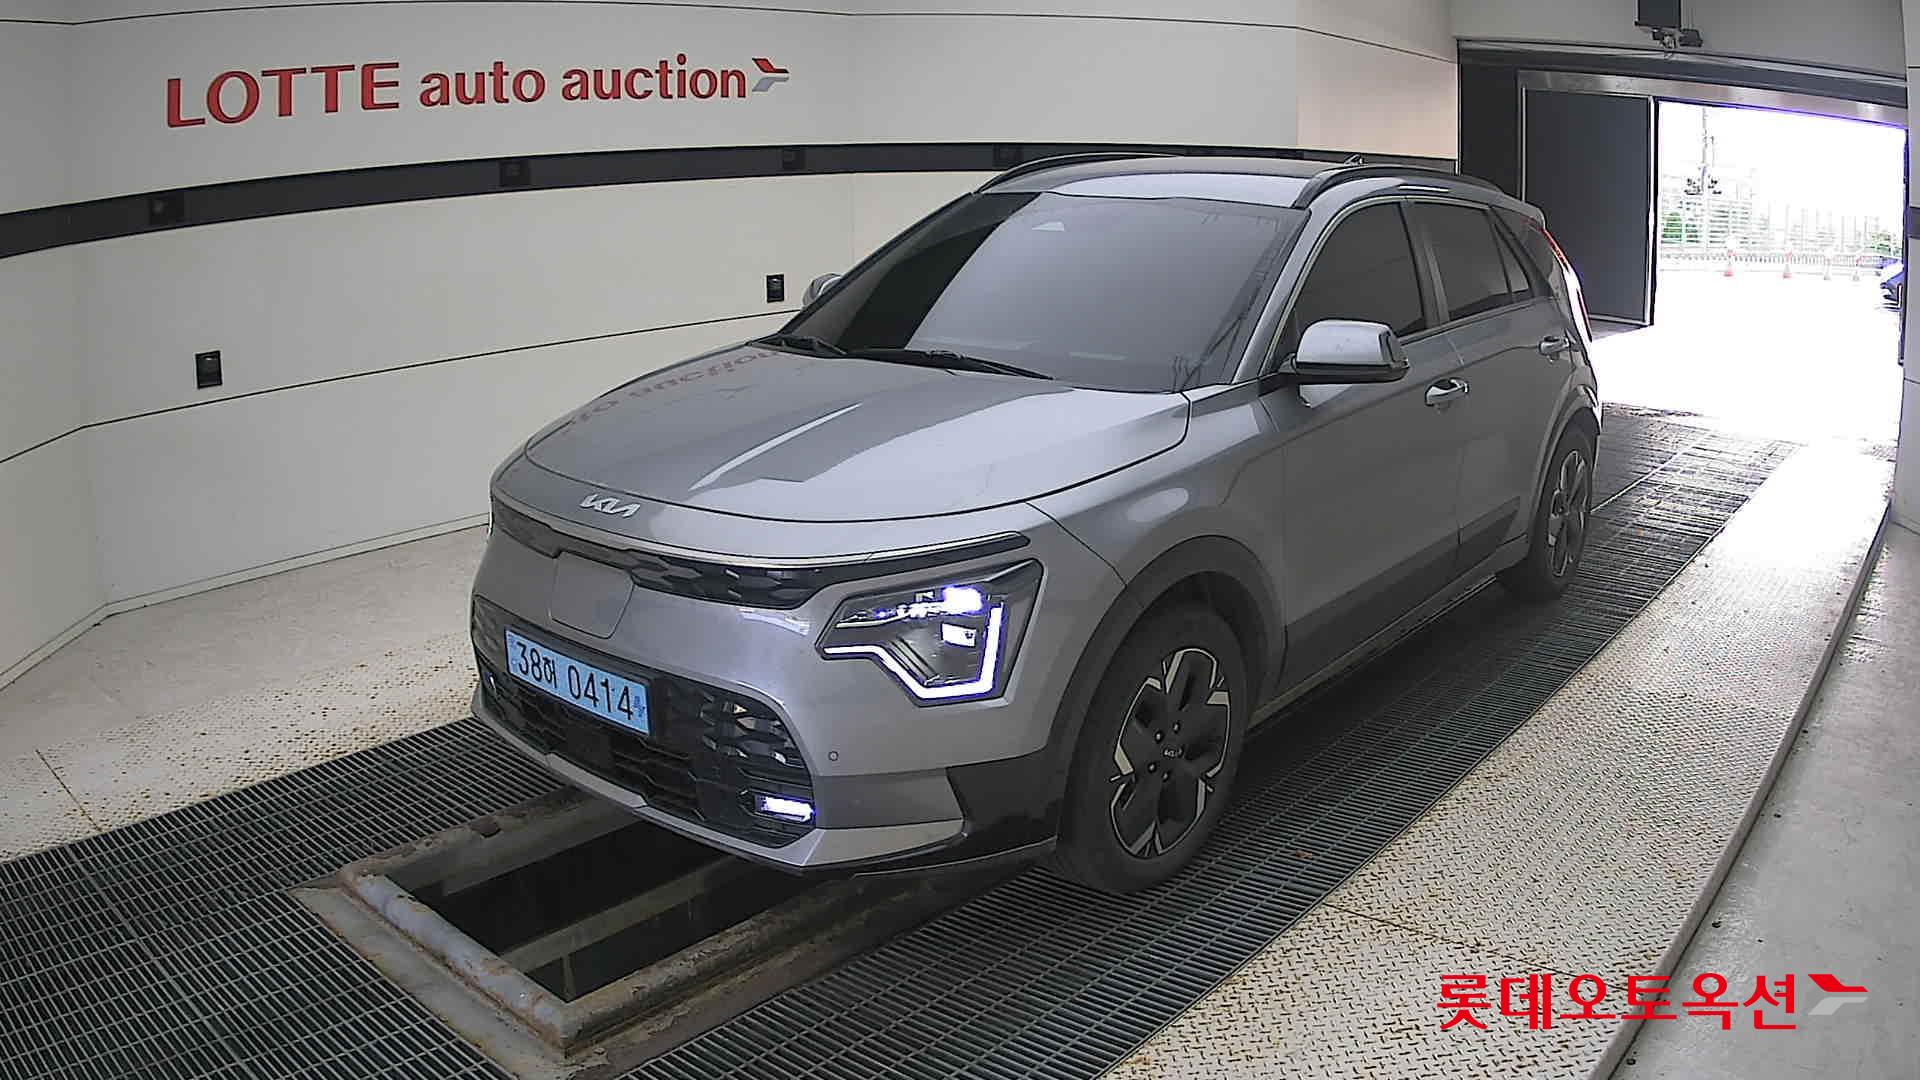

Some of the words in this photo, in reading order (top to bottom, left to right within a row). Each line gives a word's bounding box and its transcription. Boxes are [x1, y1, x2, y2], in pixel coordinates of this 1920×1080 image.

[166, 62, 399, 128] LOTTE
[419, 61, 546, 107] auto
[561, 53, 747, 100] auction
[579, 493, 641, 519] KIA
[567, 664, 634, 721] 0414
